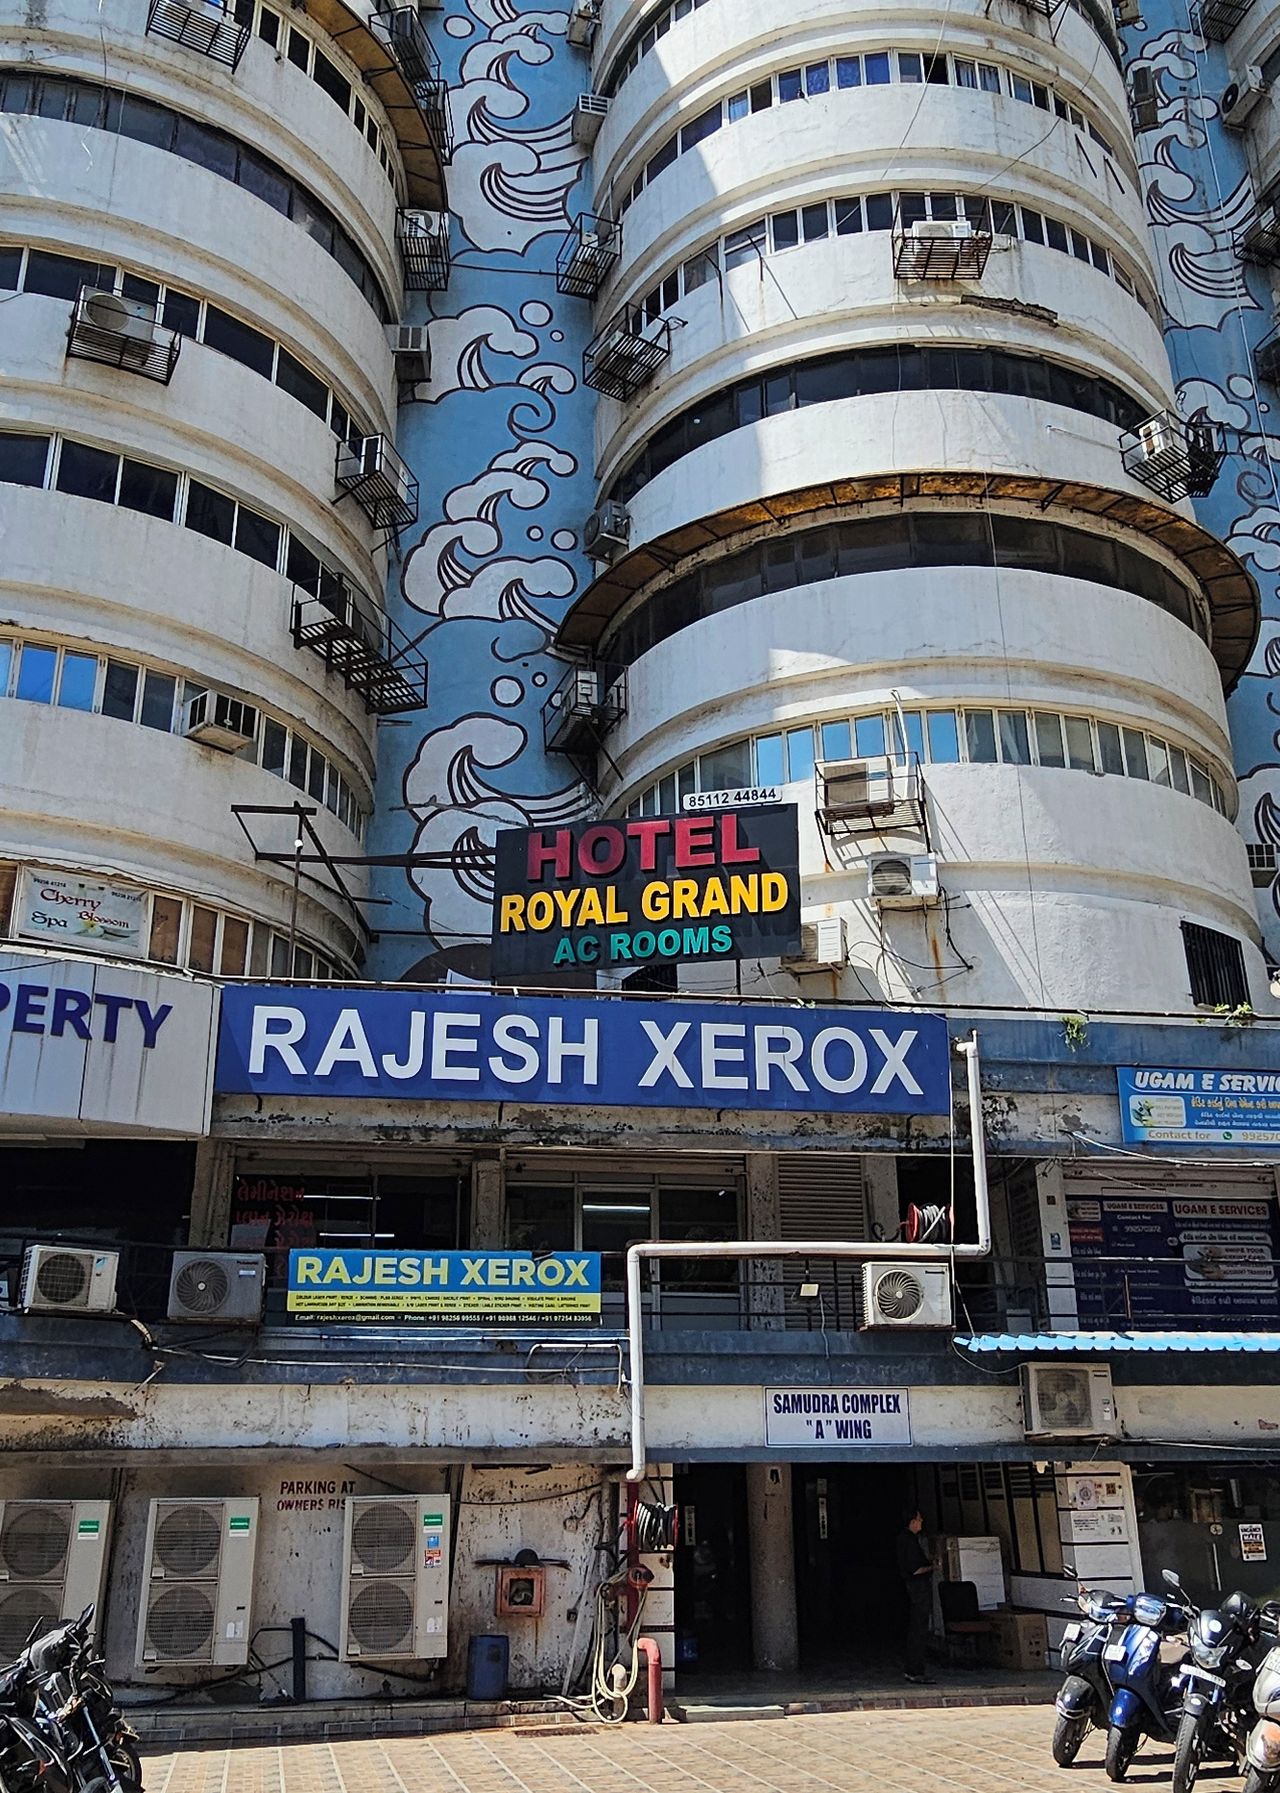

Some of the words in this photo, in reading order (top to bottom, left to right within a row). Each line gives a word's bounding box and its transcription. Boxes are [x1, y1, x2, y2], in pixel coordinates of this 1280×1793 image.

[688, 792, 730, 807] 85112
[733, 788, 777, 802] 44844
[527, 813, 760, 881] HOTEL
[40, 888, 102, 911] Cherry
[500, 885, 628, 933] ROYAL
[641, 872, 789, 921] GRAND
[31, 911, 68, 928] Spa
[78, 911, 130, 929] Blossom
[553, 934, 600, 965] AC
[610, 924, 733, 961] ROOMS
[248, 1004, 598, 1086] RAJESH
[638, 1019, 926, 1096] XEROX
[1134, 1071, 1194, 1090] UGAM
[1201, 1073, 1215, 1090] E
[1148, 1130, 1191, 1140] Contact
[1192, 1130, 1210, 1140] for
[1175, 1202, 1207, 1215] UGAM
[1210, 1203, 1217, 1214] E
[1218, 1203, 1267, 1216] SERVICES
[296, 1256, 449, 1285] RAJESH
[460, 1258, 590, 1286] XEROX
[773, 1393, 839, 1414] SAMUDRA
[842, 1393, 901, 1414] COMPLEX
[835, 1419, 872, 1439] WING
[280, 1480, 336, 1495] PARKING
[340, 1481, 356, 1494] AT
[276, 1498, 324, 1511] OWNERS
[328, 1498, 346, 1510] RIS
